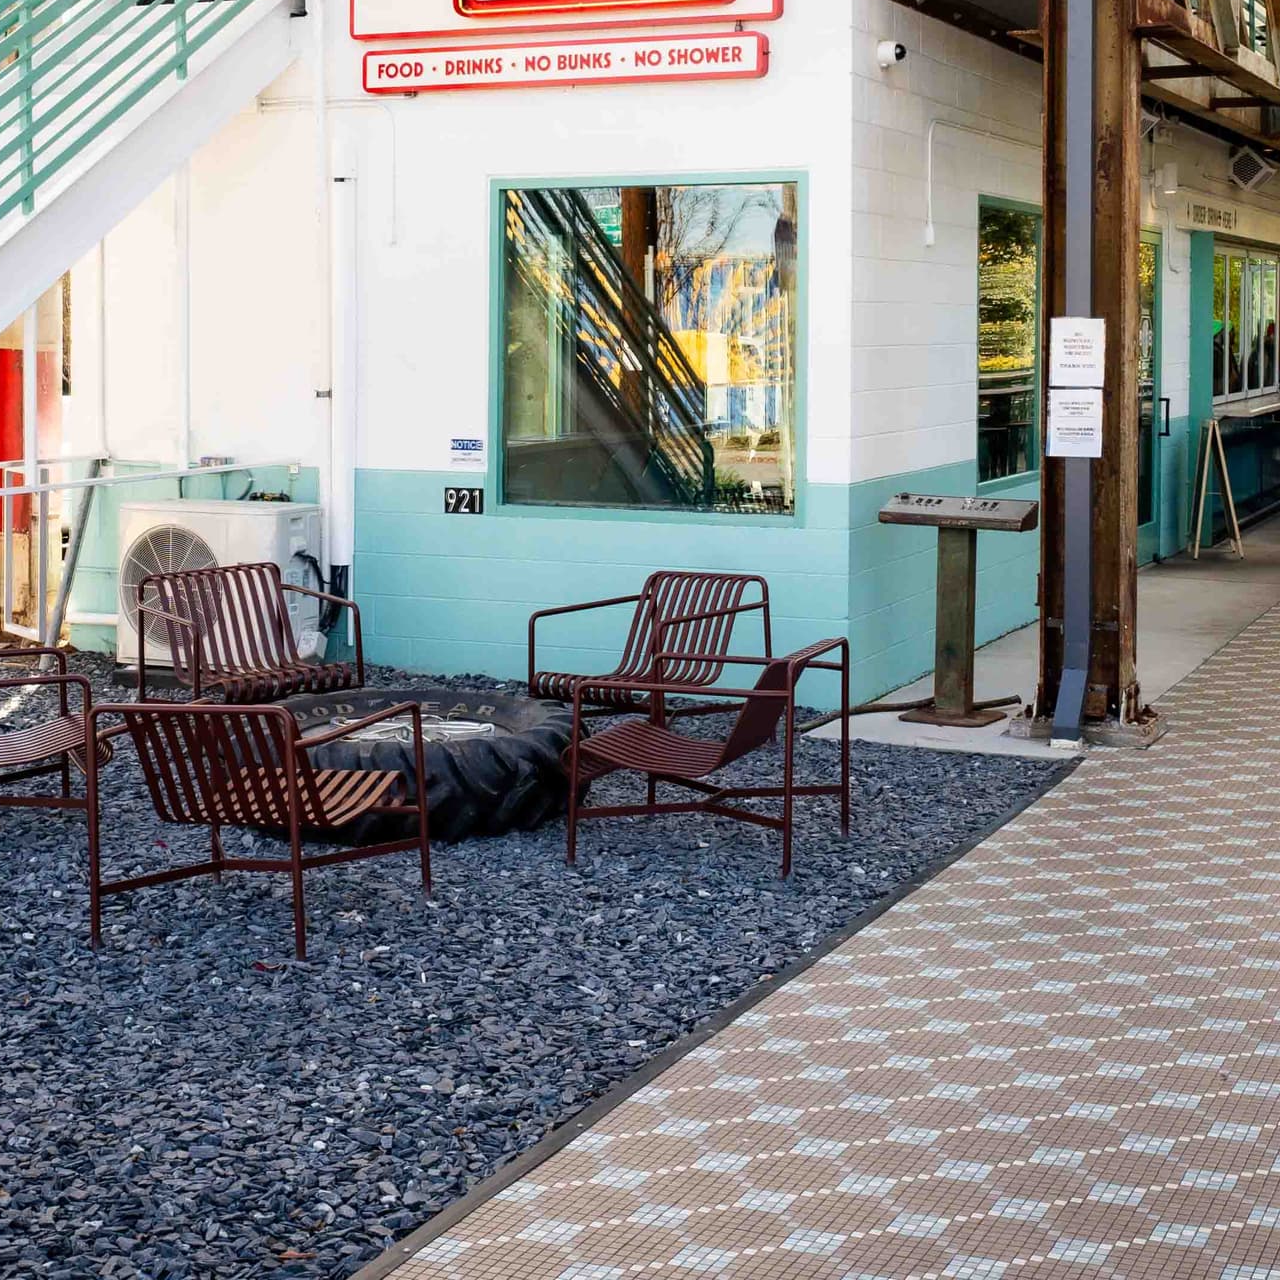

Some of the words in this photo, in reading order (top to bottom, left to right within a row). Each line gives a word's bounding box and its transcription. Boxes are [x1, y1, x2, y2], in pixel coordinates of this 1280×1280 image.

[377, 61, 424, 79] FOOD
[445, 57, 503, 76] DRINKS
[524, 55, 551, 72] NO
[557, 51, 612, 71] BUNKS
[634, 49, 662, 67] NO
[667, 45, 743, 66] SHOWER
[450, 440, 483, 450] NOTICE
[445, 488, 480, 513] 921
